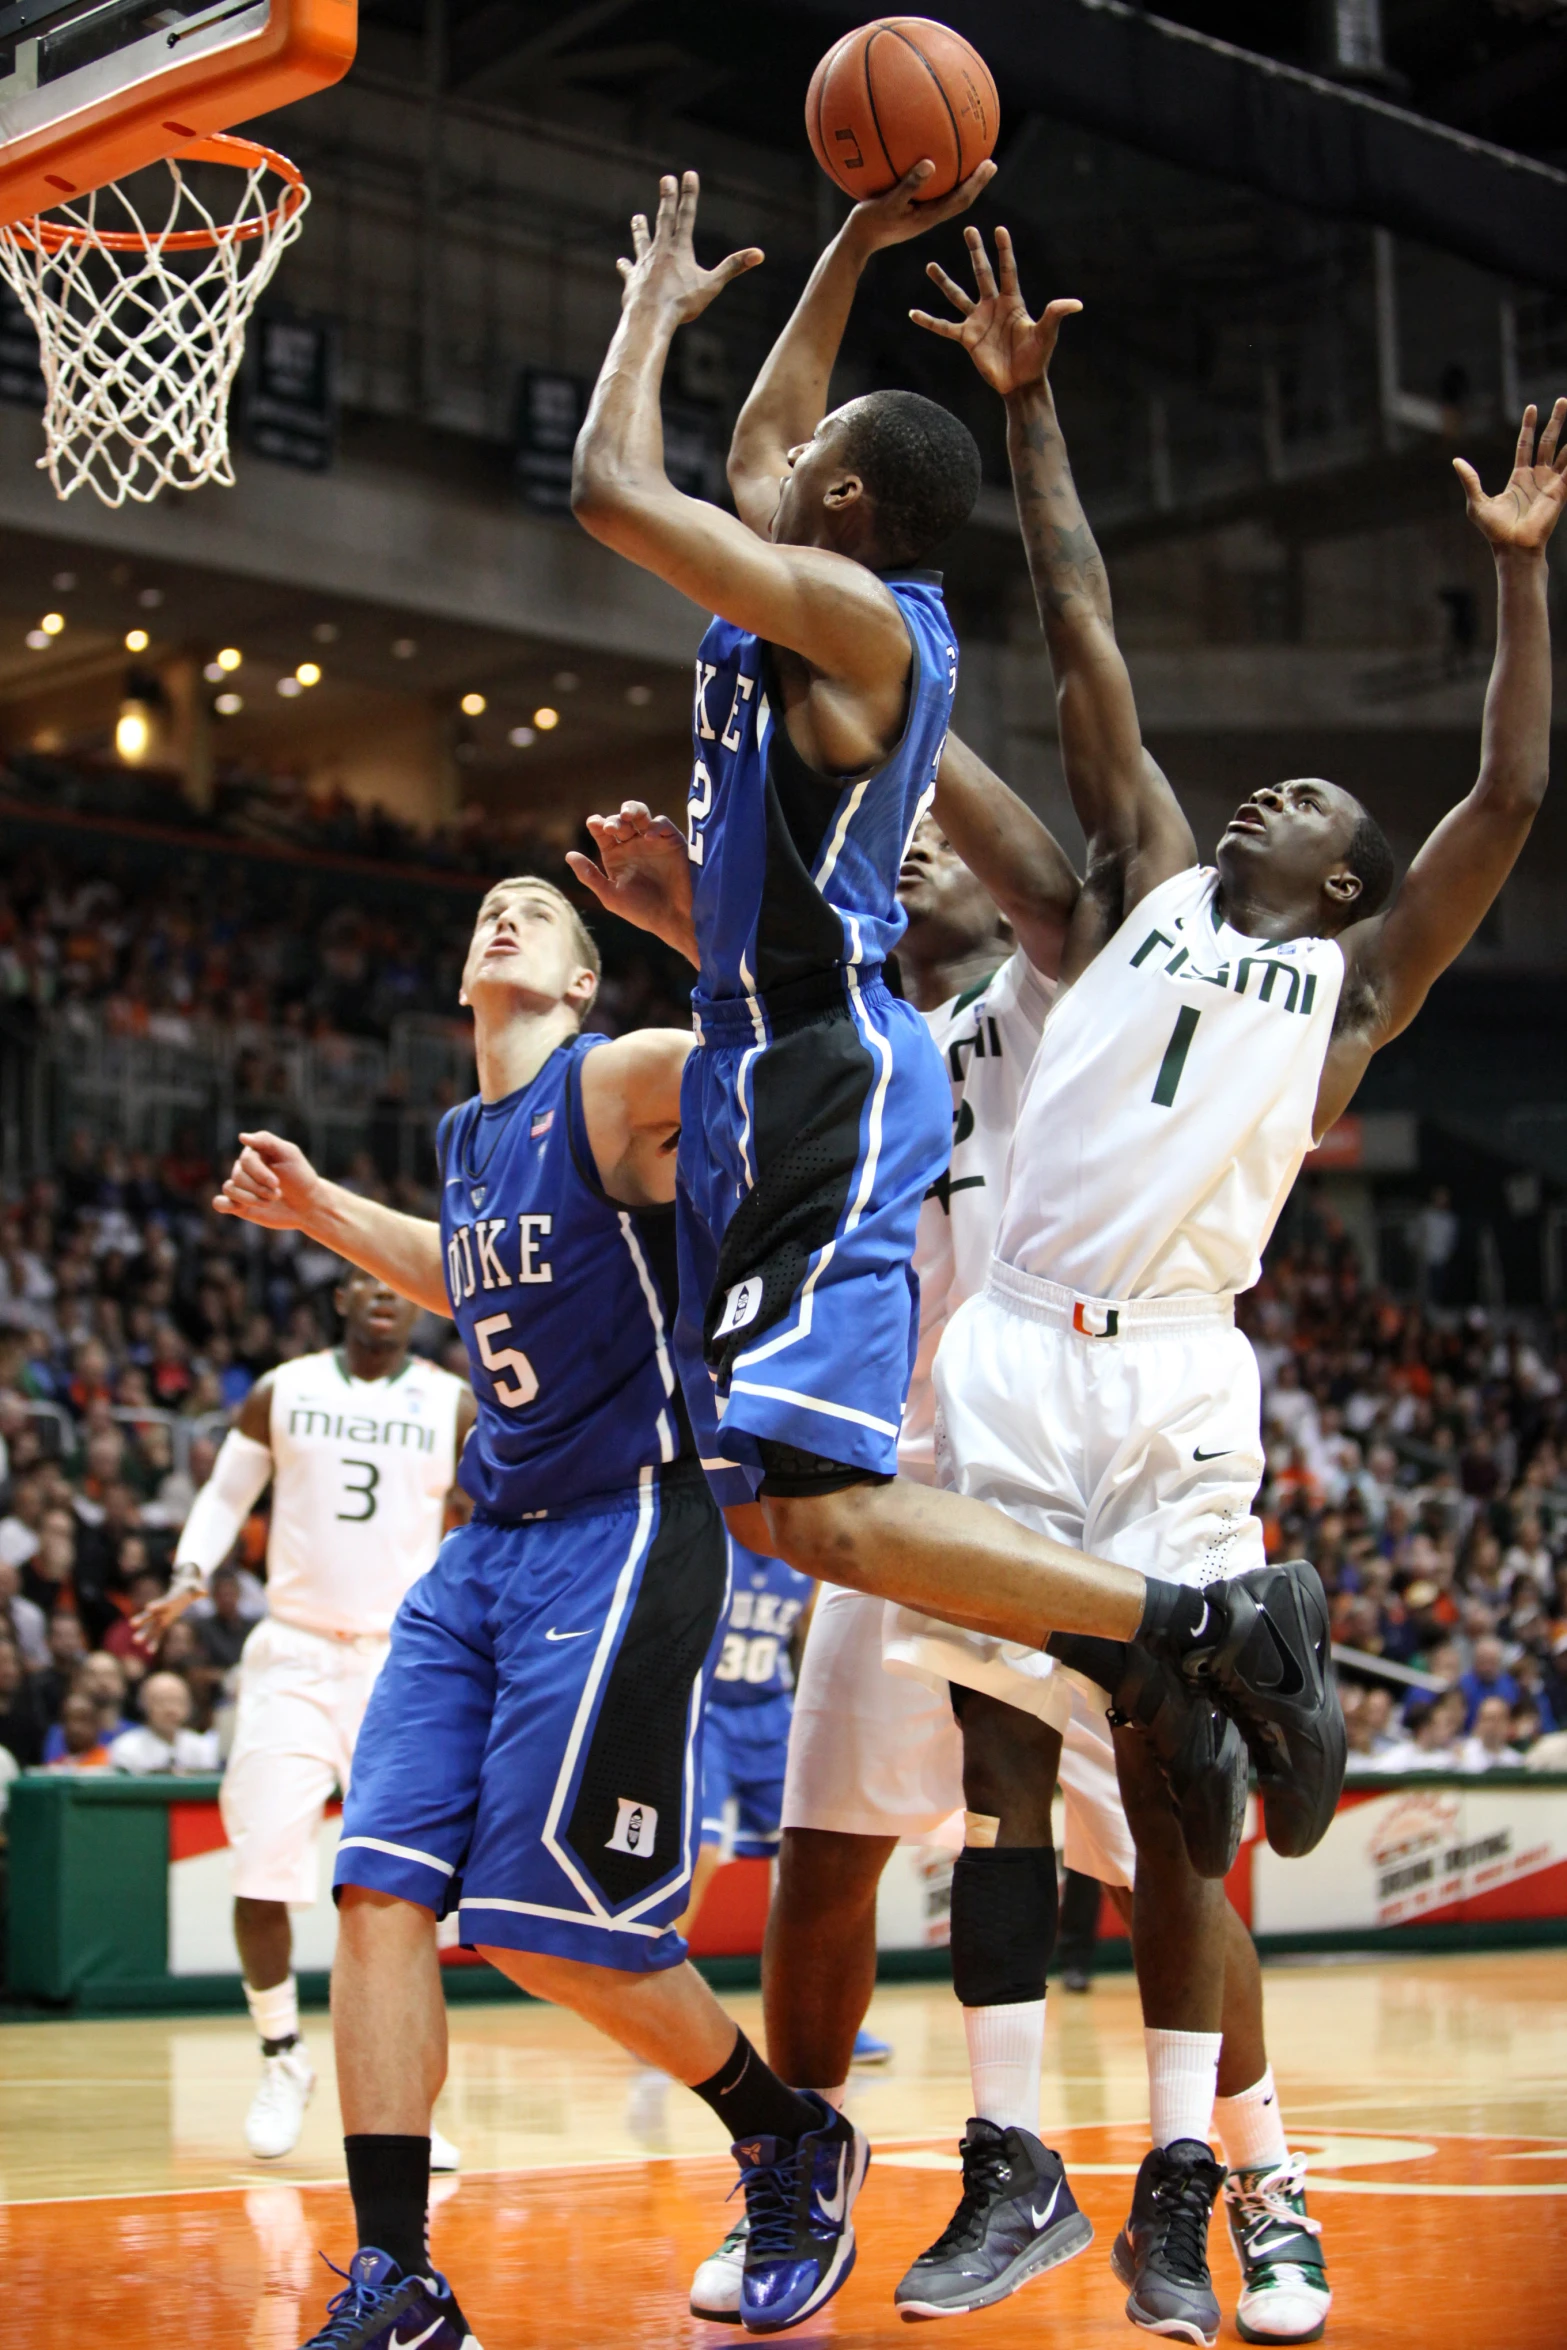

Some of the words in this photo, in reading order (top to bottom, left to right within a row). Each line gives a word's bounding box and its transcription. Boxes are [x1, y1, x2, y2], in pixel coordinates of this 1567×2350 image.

[695, 659, 754, 752] KE
[1151, 1005, 1201, 1107] 1
[1073, 1302, 1119, 1337] U
[474, 1313, 540, 1408] 5
[336, 1458, 380, 1522] 3
[714, 1633, 778, 1684] 30
